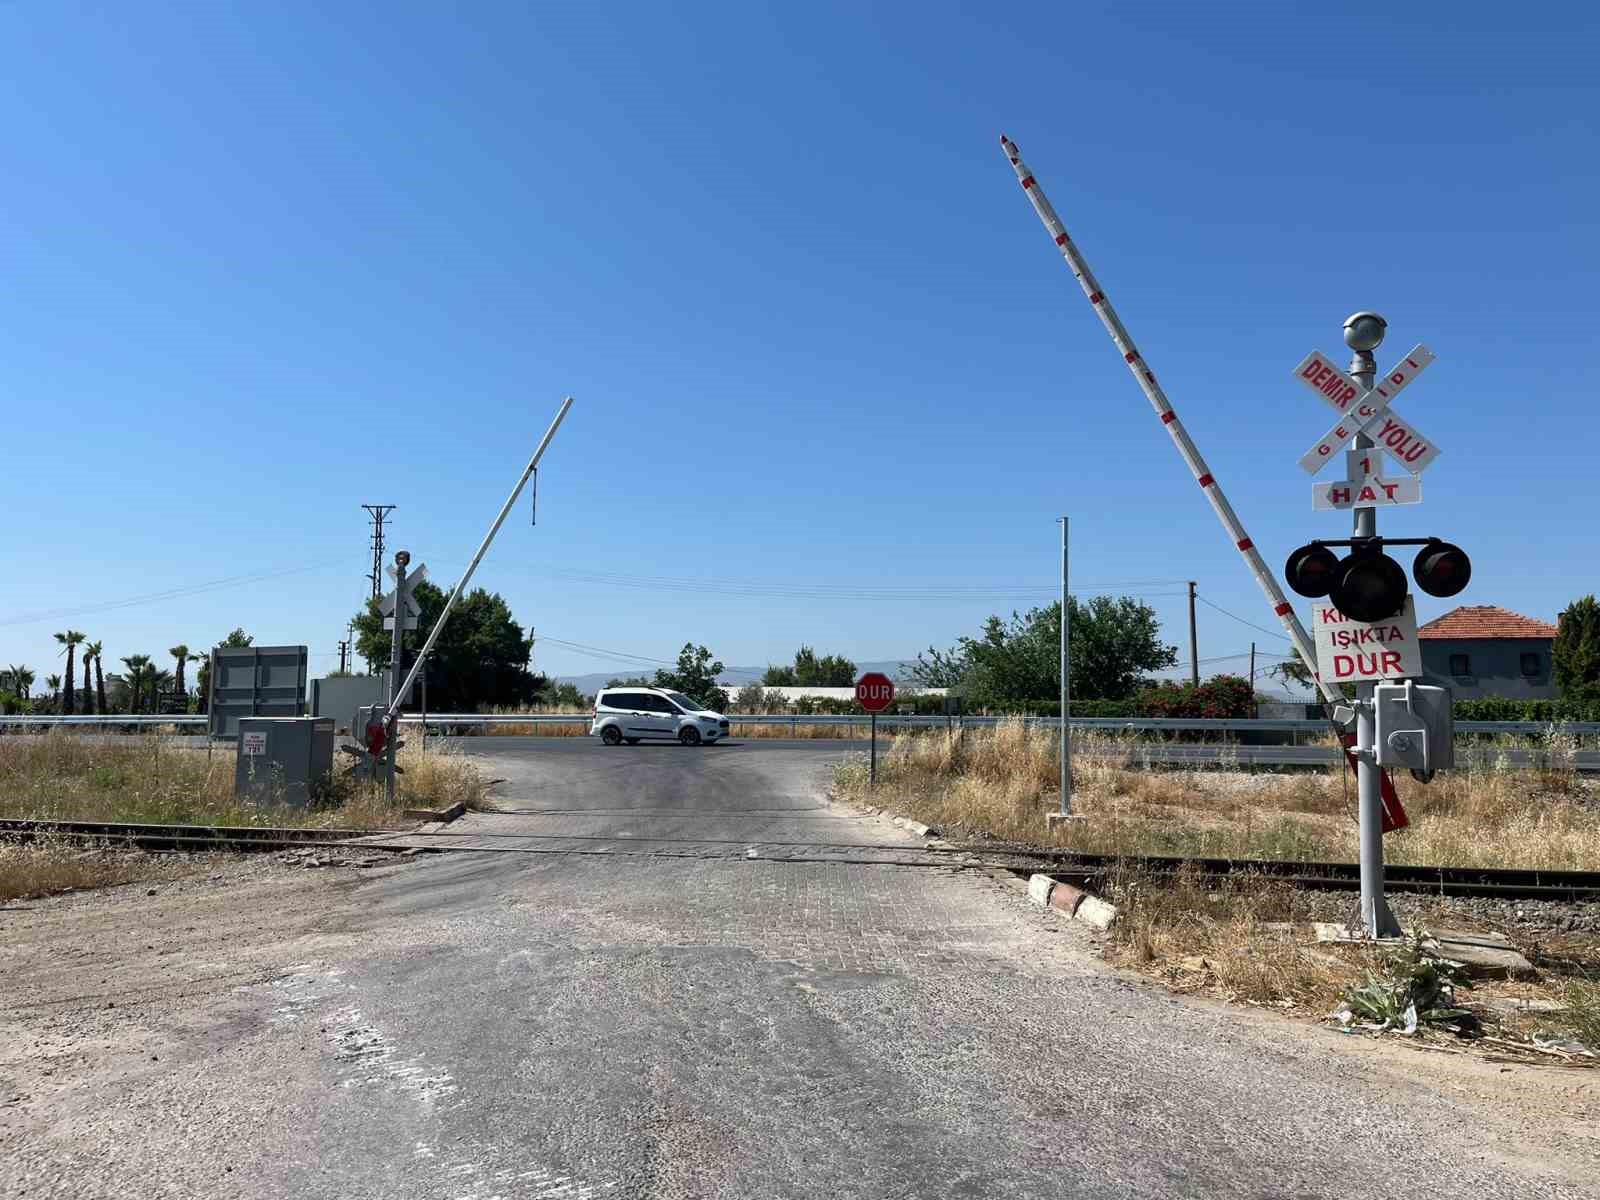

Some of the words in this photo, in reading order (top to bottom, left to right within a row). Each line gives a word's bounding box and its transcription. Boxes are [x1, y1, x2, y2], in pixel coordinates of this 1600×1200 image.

[1378, 419, 1427, 463] YOLU
[1359, 457, 1371, 474] 1
[1332, 484, 1399, 503] HAT
[1331, 626, 1404, 649] IŞIKTA
[1333, 651, 1405, 678] DUR
[858, 684, 890, 700] DUR
